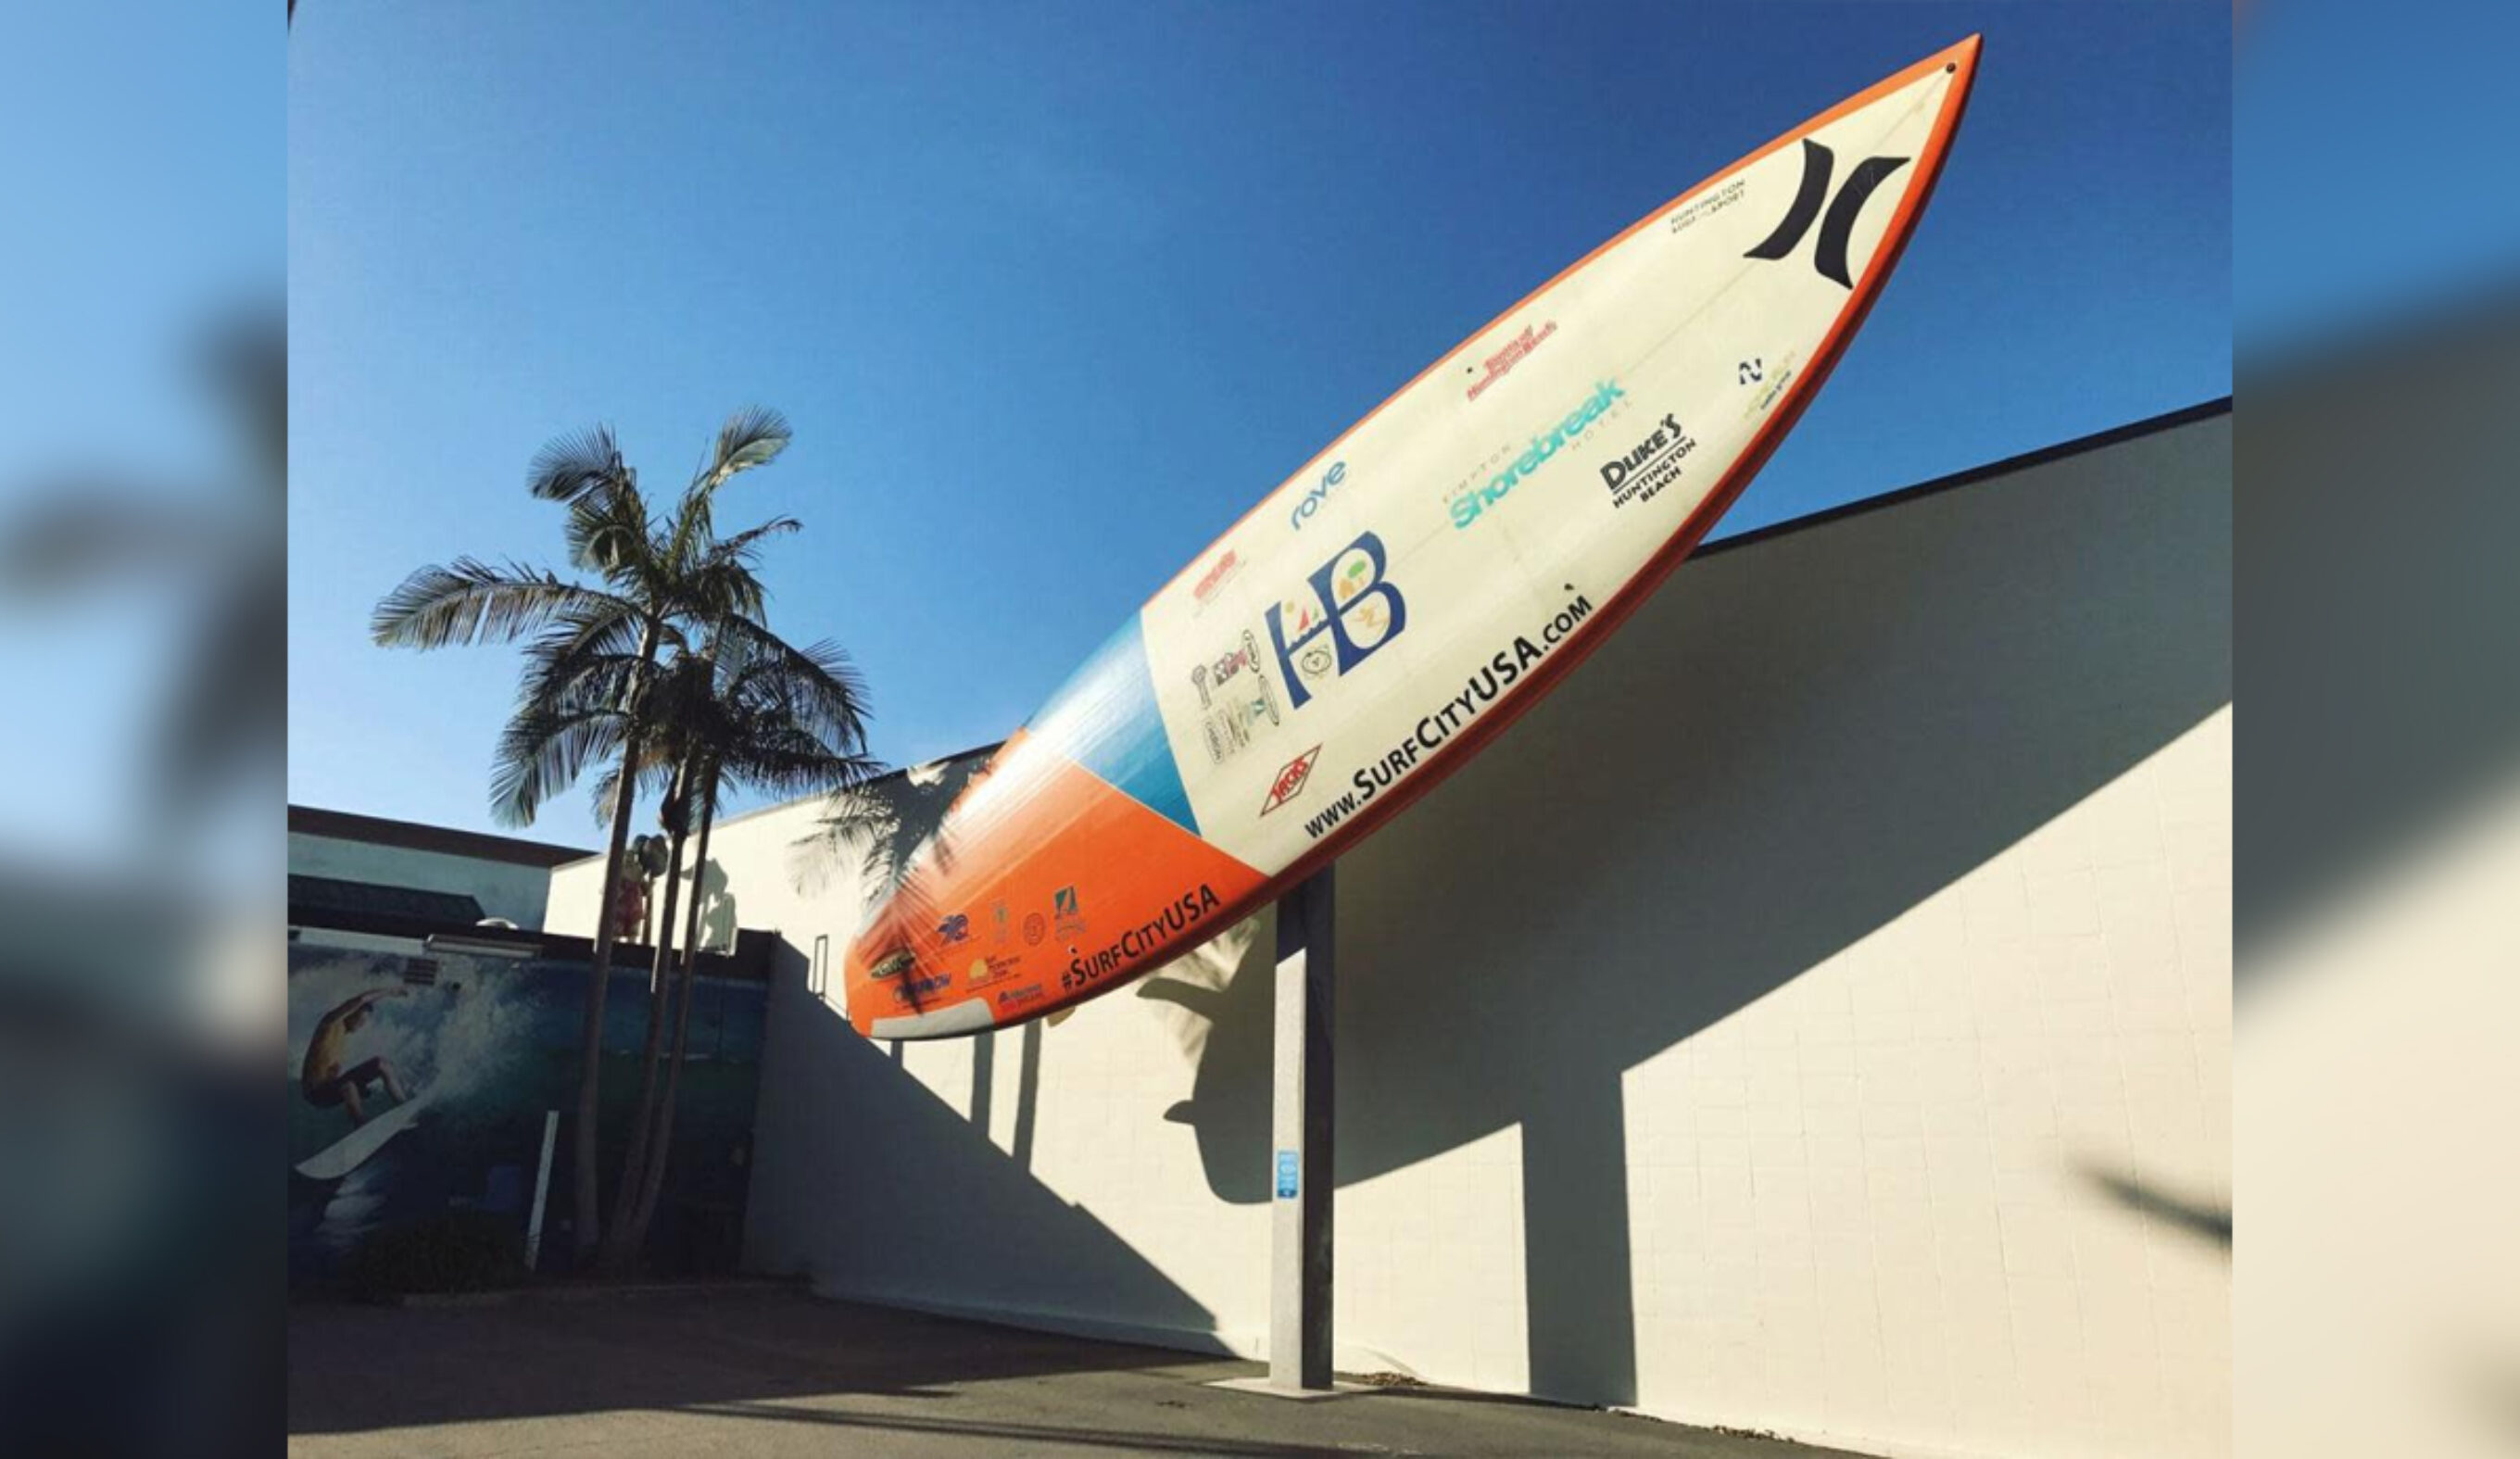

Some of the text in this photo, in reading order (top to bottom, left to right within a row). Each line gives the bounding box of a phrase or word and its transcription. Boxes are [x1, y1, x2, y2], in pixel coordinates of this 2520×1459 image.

[1449, 378, 1626, 530] Shorebreak
[1600, 413, 1682, 491] DUKE'S
[1612, 437, 1696, 509] HUNTINGTON
[1639, 466, 1682, 503] BEACH
[1292, 461, 1346, 530] rove
